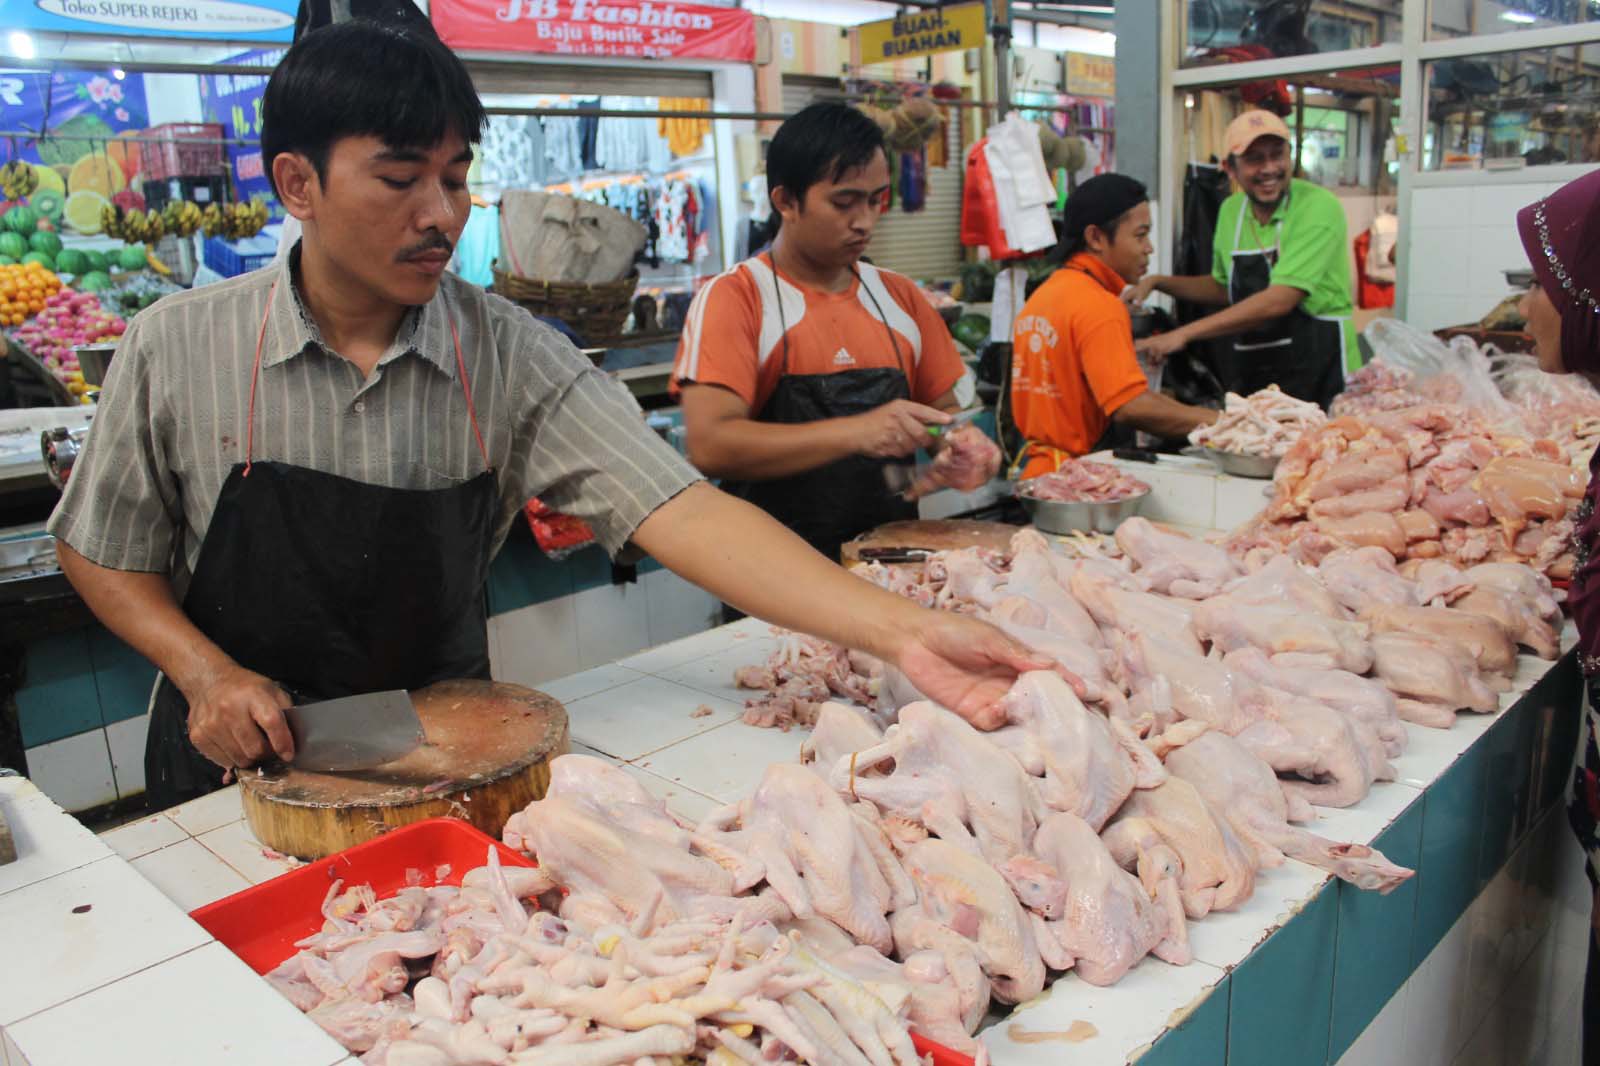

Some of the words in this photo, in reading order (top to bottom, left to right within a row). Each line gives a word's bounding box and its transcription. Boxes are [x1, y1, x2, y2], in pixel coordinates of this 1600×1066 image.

[60, 0, 97, 14] Toko
[99, 2, 149, 18] SUPER
[151, 5, 198, 21] REJEKI
[496, 0, 559, 22] JB
[569, 0, 713, 30] Fashion
[536, 21, 583, 43] Baju
[590, 24, 644, 43] Butik
[651, 28, 685, 45] Sale
[882, 29, 961, 58] BUAHAN
